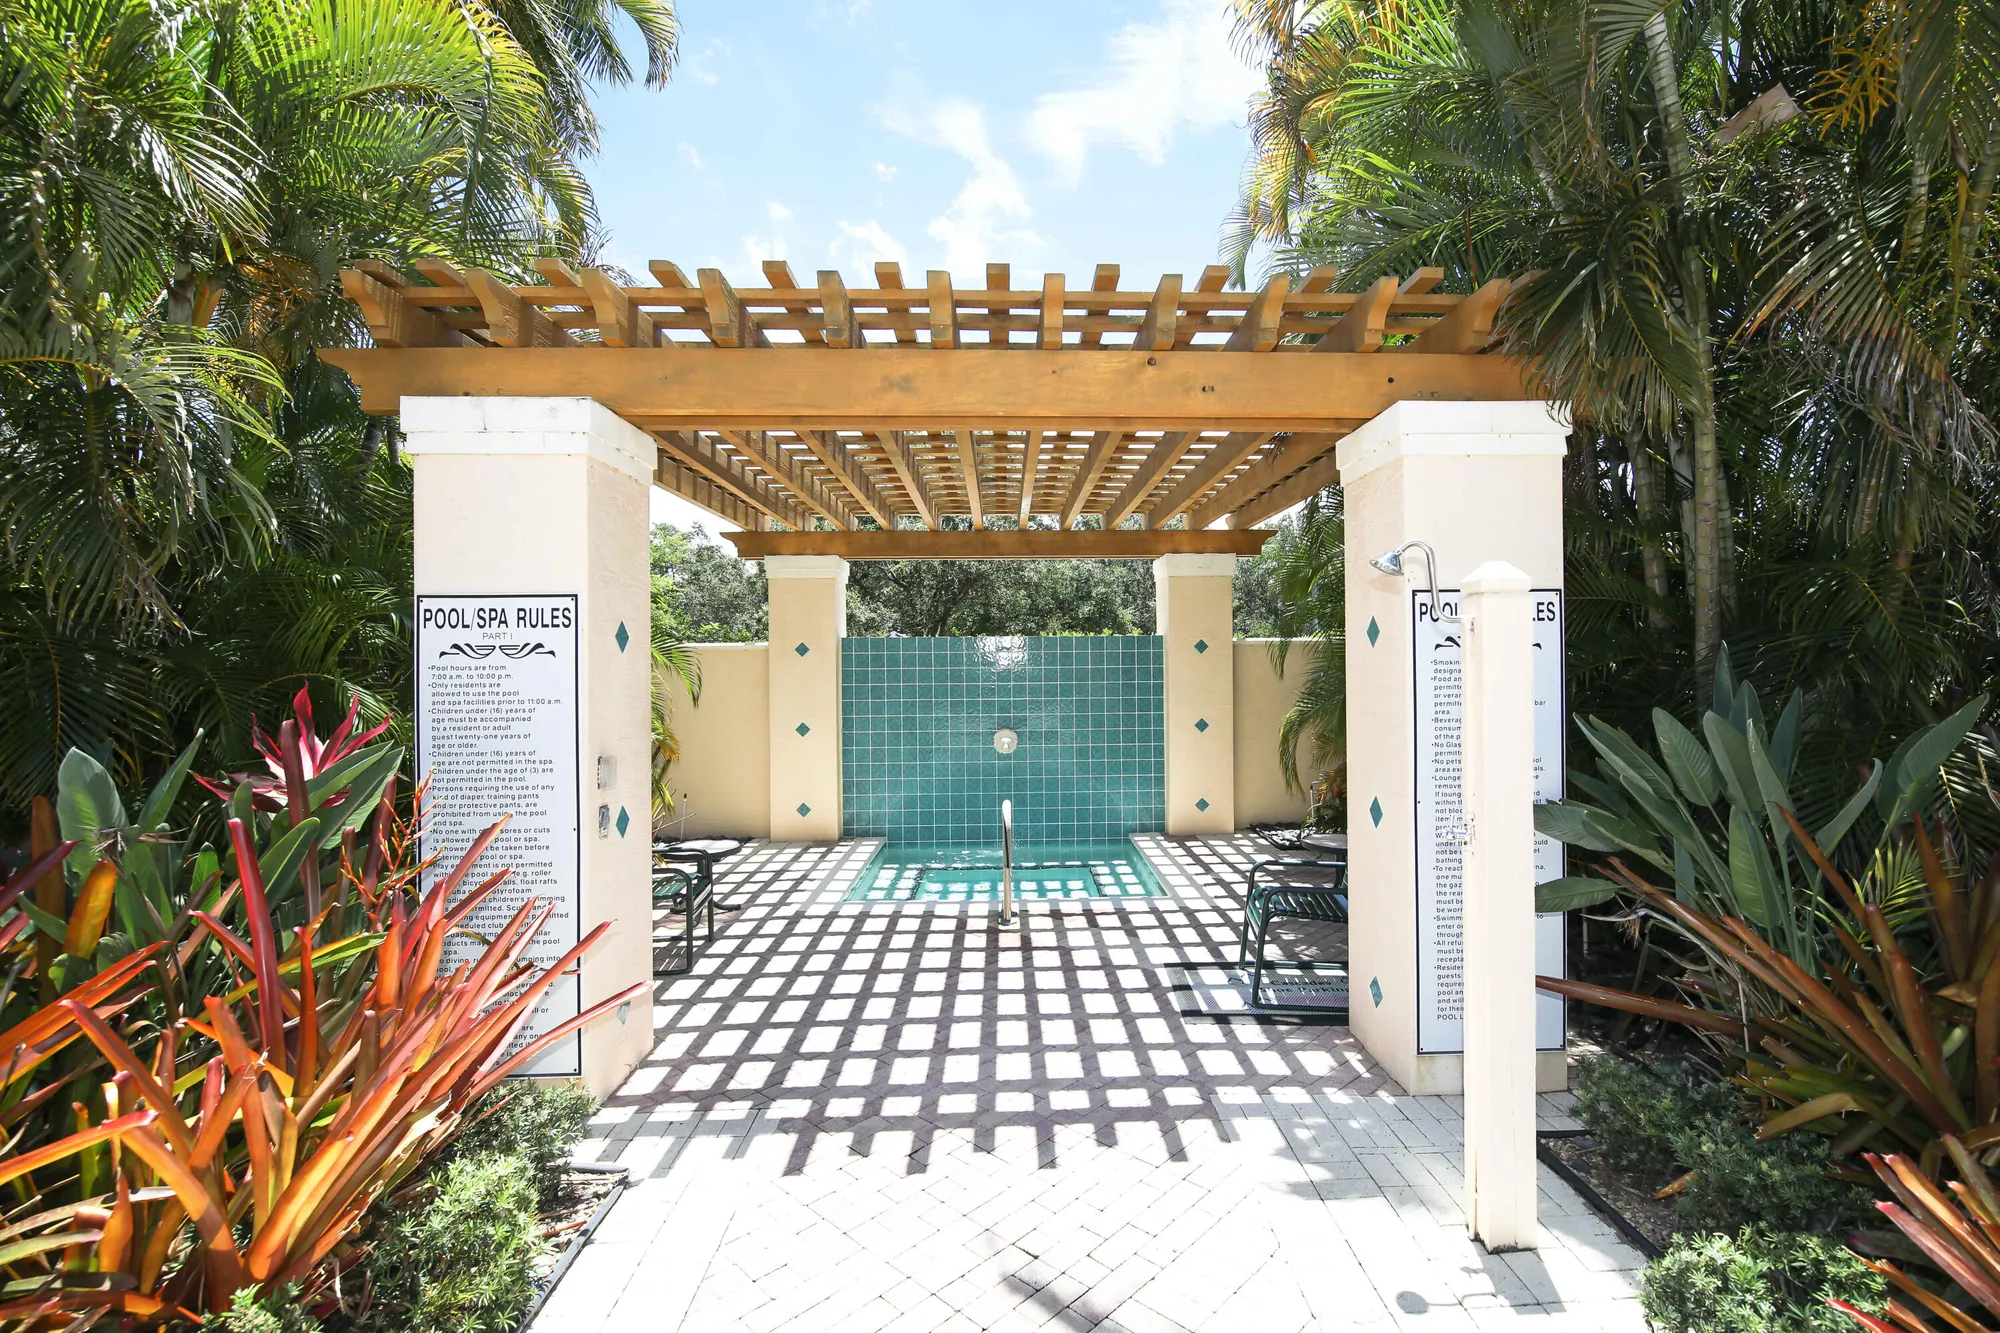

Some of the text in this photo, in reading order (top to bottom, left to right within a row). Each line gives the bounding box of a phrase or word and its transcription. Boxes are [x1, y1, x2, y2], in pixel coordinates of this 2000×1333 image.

[423, 607, 572, 631] POOL/SPA RULES
[482, 632, 513, 640] PART I
[431, 682, 448, 690] Only
[446, 776, 483, 784] permitted
[487, 793, 516, 801] training
[458, 802, 497, 810] protective
[432, 811, 471, 820] prohibited
[494, 836, 512, 844] pool
[479, 853, 497, 862] pool
[432, 862, 449, 871] Play
[515, 861, 552, 869] permitted
